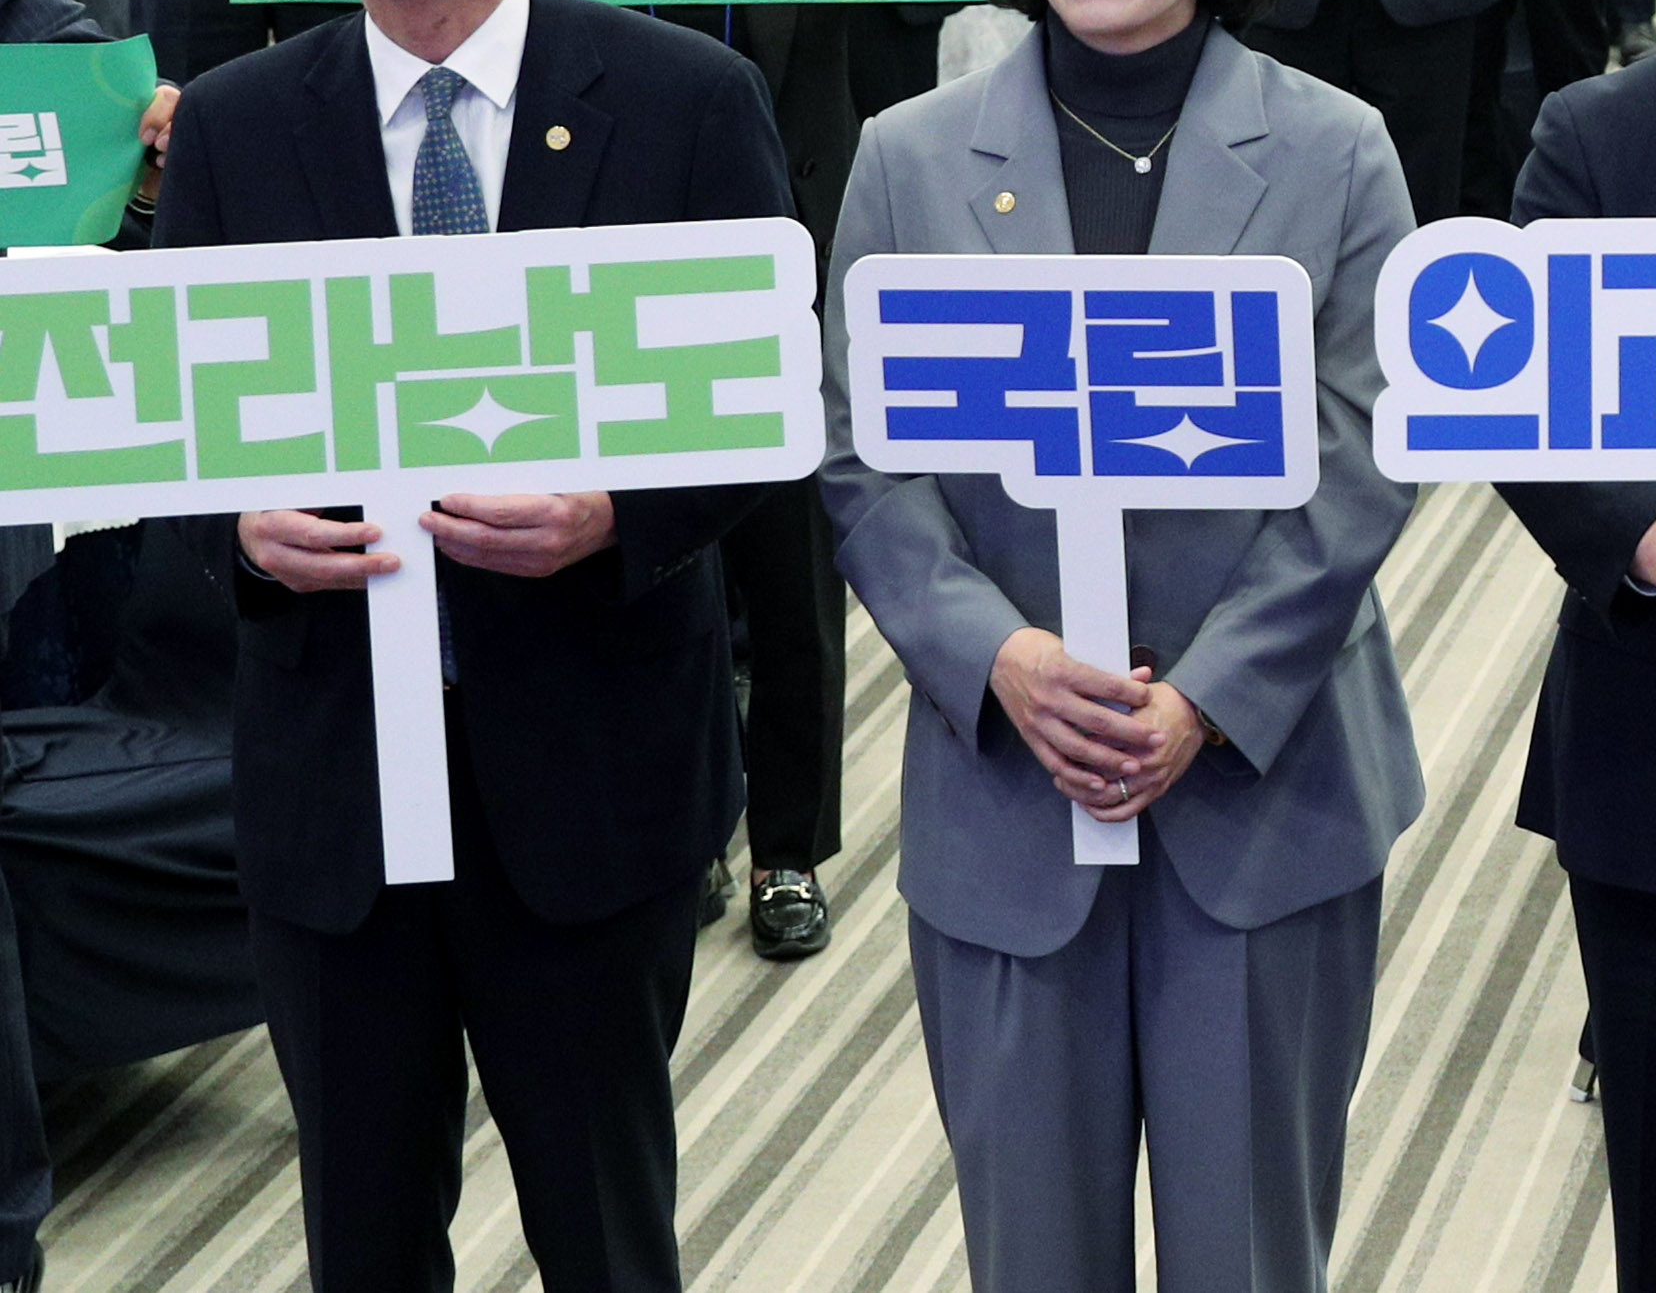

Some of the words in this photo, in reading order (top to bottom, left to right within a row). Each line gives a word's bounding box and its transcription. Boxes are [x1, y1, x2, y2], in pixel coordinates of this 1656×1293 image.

[0, 111, 68, 190] 립
[0, 255, 786, 493] 전라남도
[878, 289, 1285, 478] 국립
